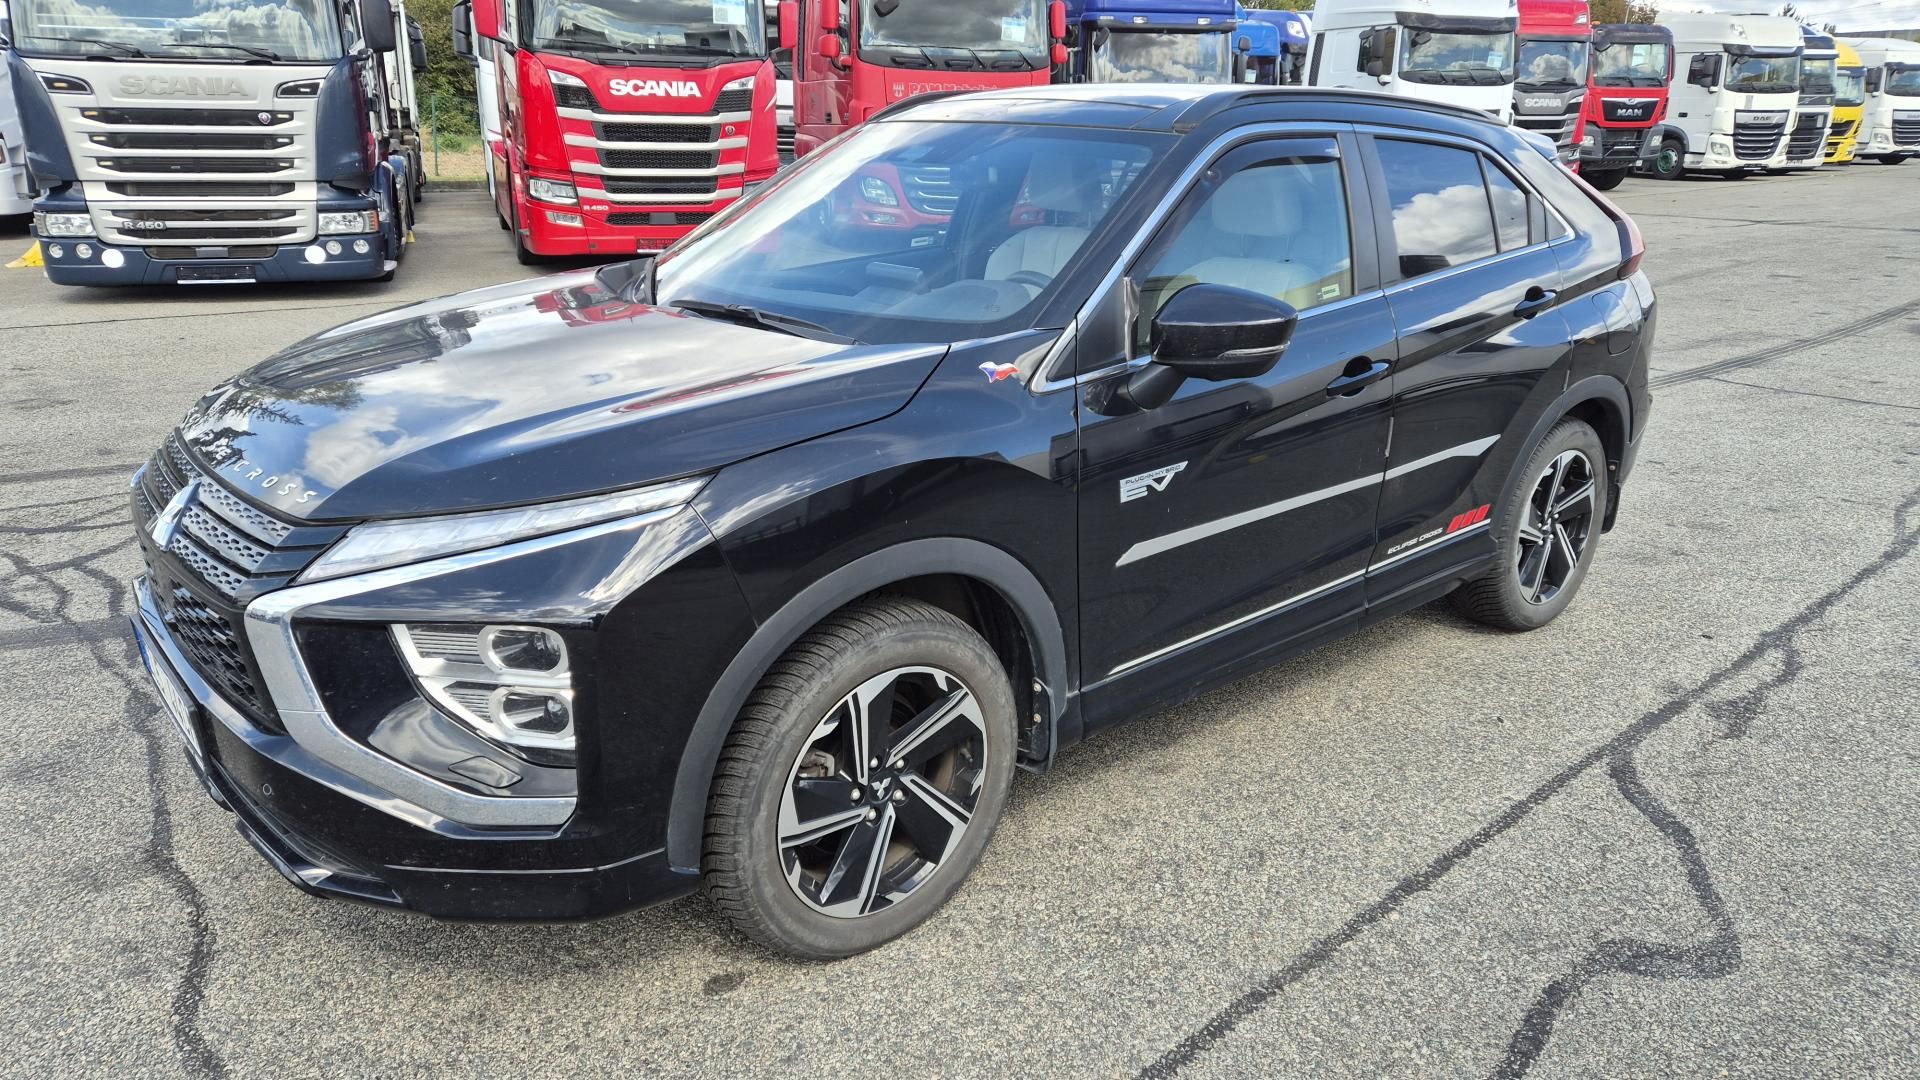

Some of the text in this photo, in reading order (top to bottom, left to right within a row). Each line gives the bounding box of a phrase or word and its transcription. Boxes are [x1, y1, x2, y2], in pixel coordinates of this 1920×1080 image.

[119, 75, 248, 96] SCANIA
[609, 79, 702, 97] SCANIA
[1524, 98, 1562, 107] SCANIA
[1617, 108, 1643, 116] MAN
[123, 221, 164, 230] R 450
[233, 460, 318, 503] CROSS
[1120, 471, 1176, 503] EV
[1387, 527, 1443, 555] ECLIPSE CROSS
